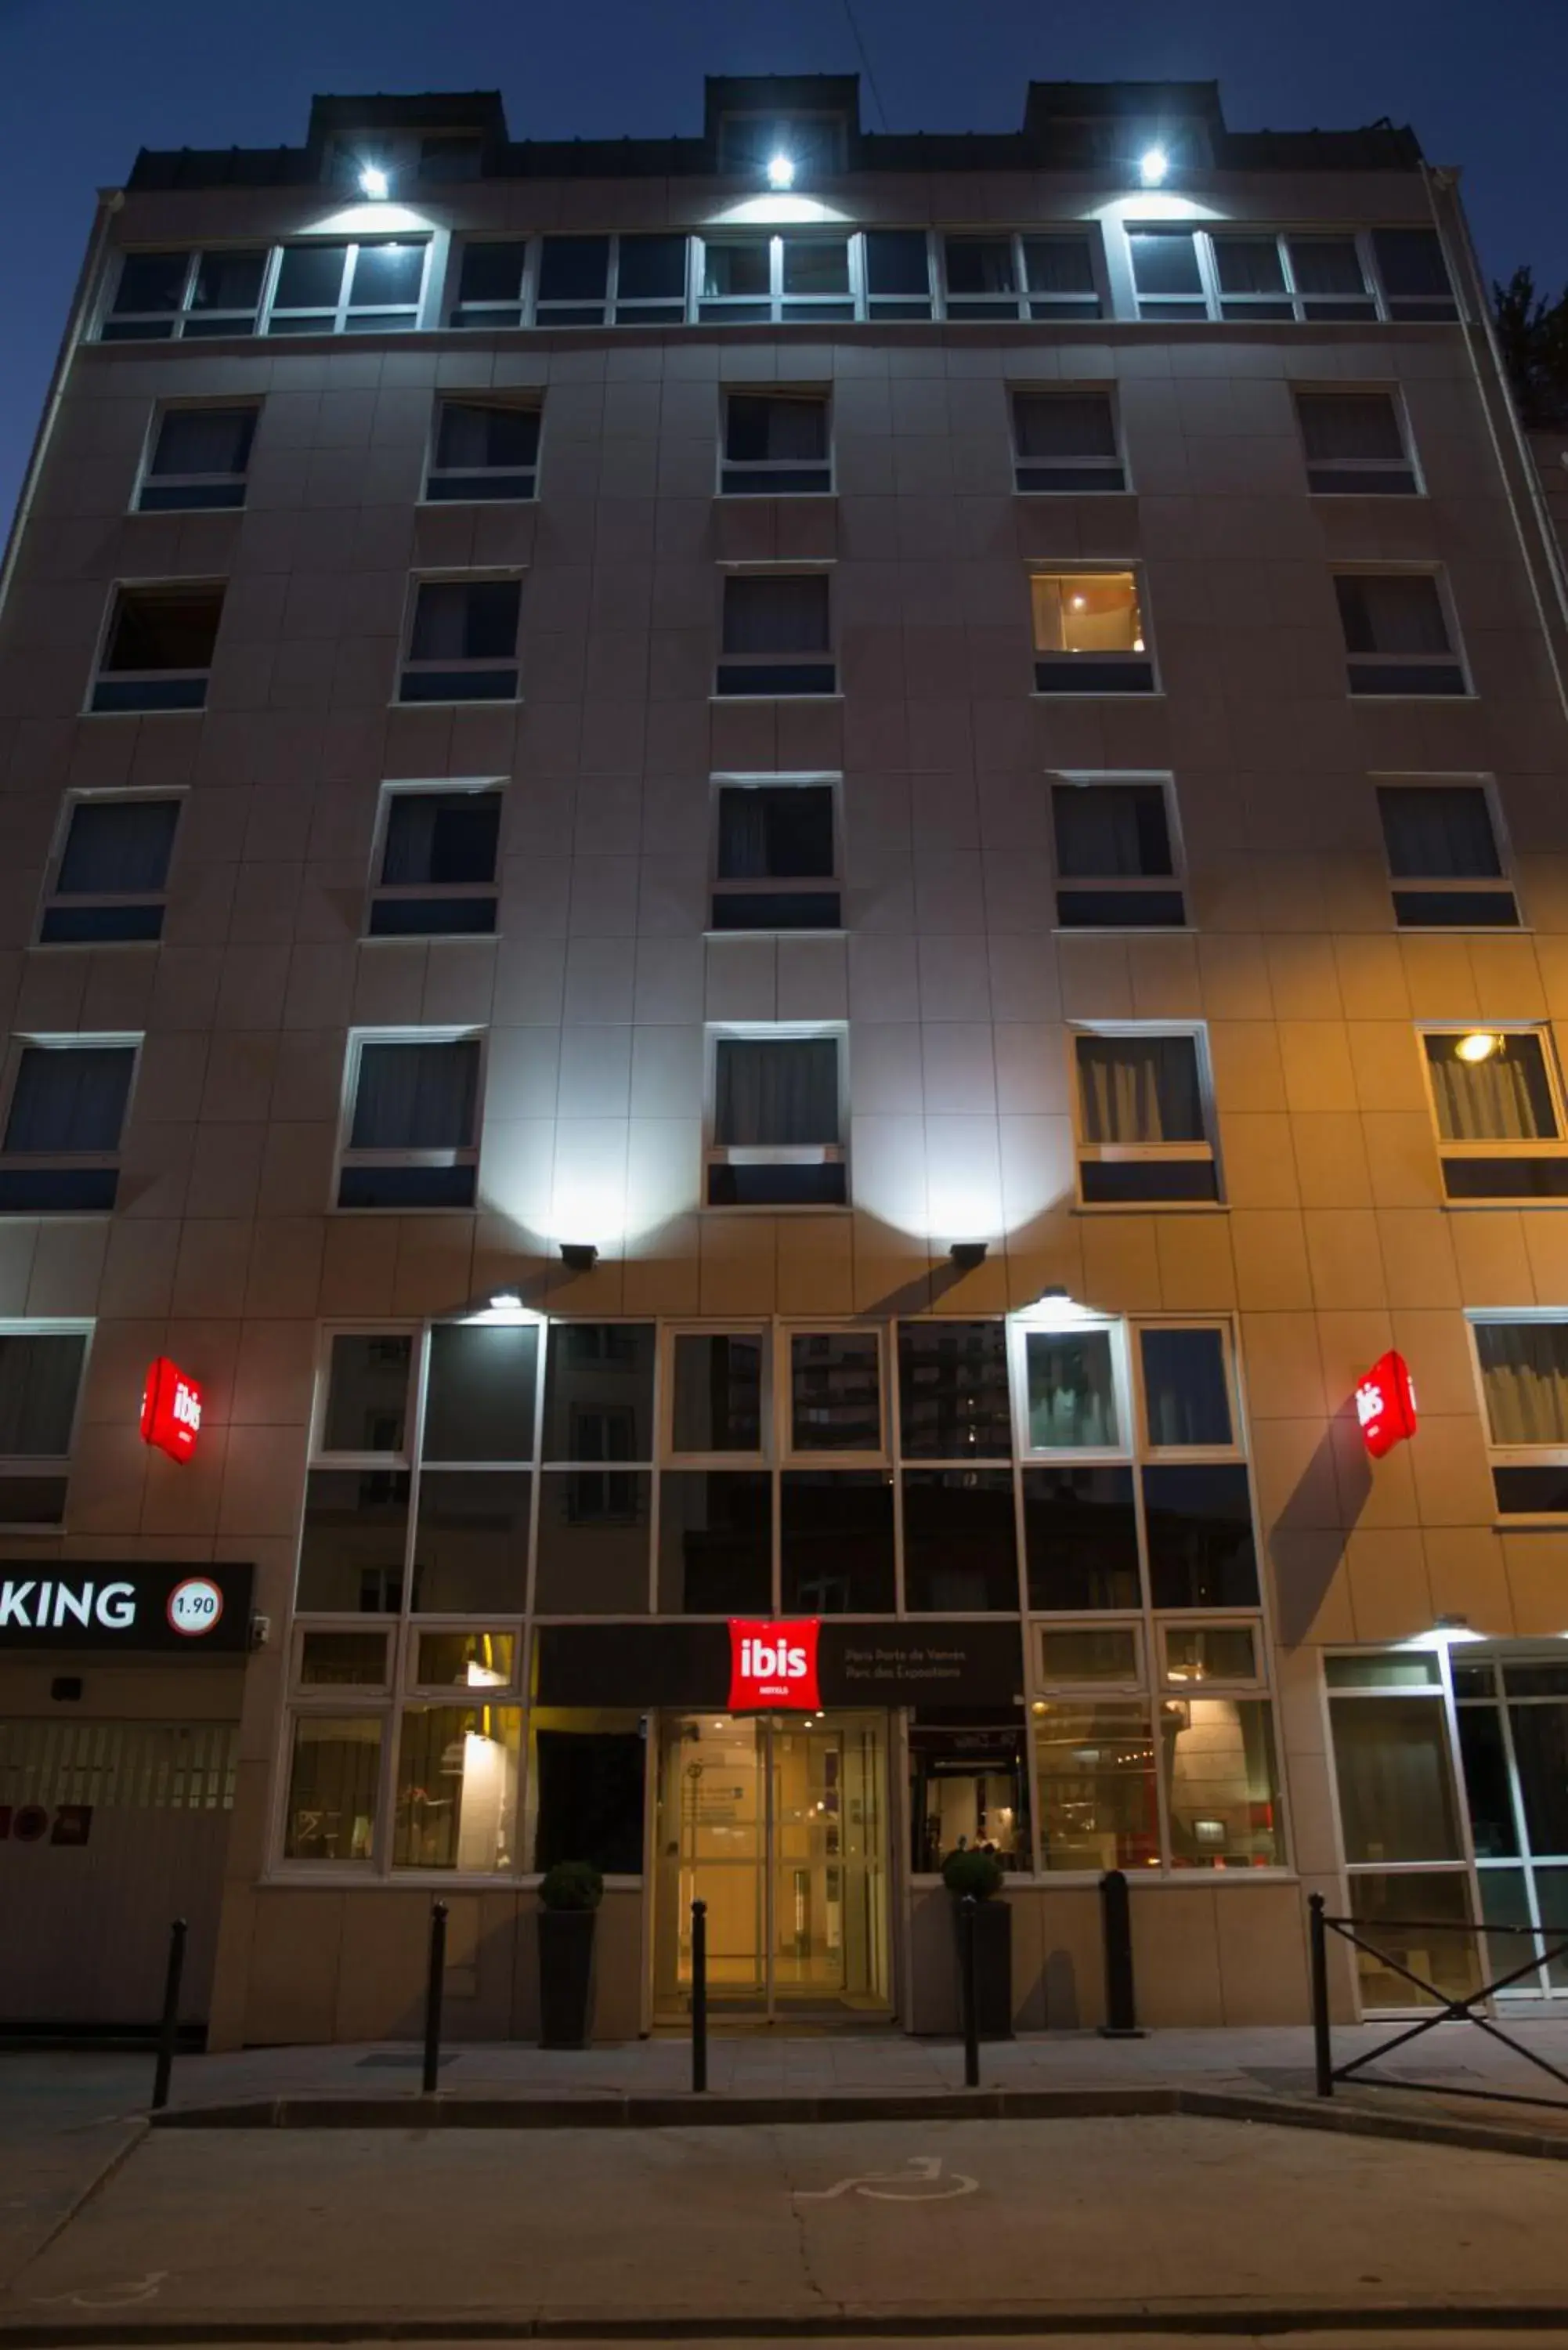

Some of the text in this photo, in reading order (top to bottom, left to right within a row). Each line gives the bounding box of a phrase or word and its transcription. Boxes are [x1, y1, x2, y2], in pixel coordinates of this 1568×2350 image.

[173, 1382, 201, 1431] ibis
[1355, 1382, 1384, 1426] ibis
[176, 1596, 214, 1614] 1.90
[740, 1638, 807, 1678] ibis
